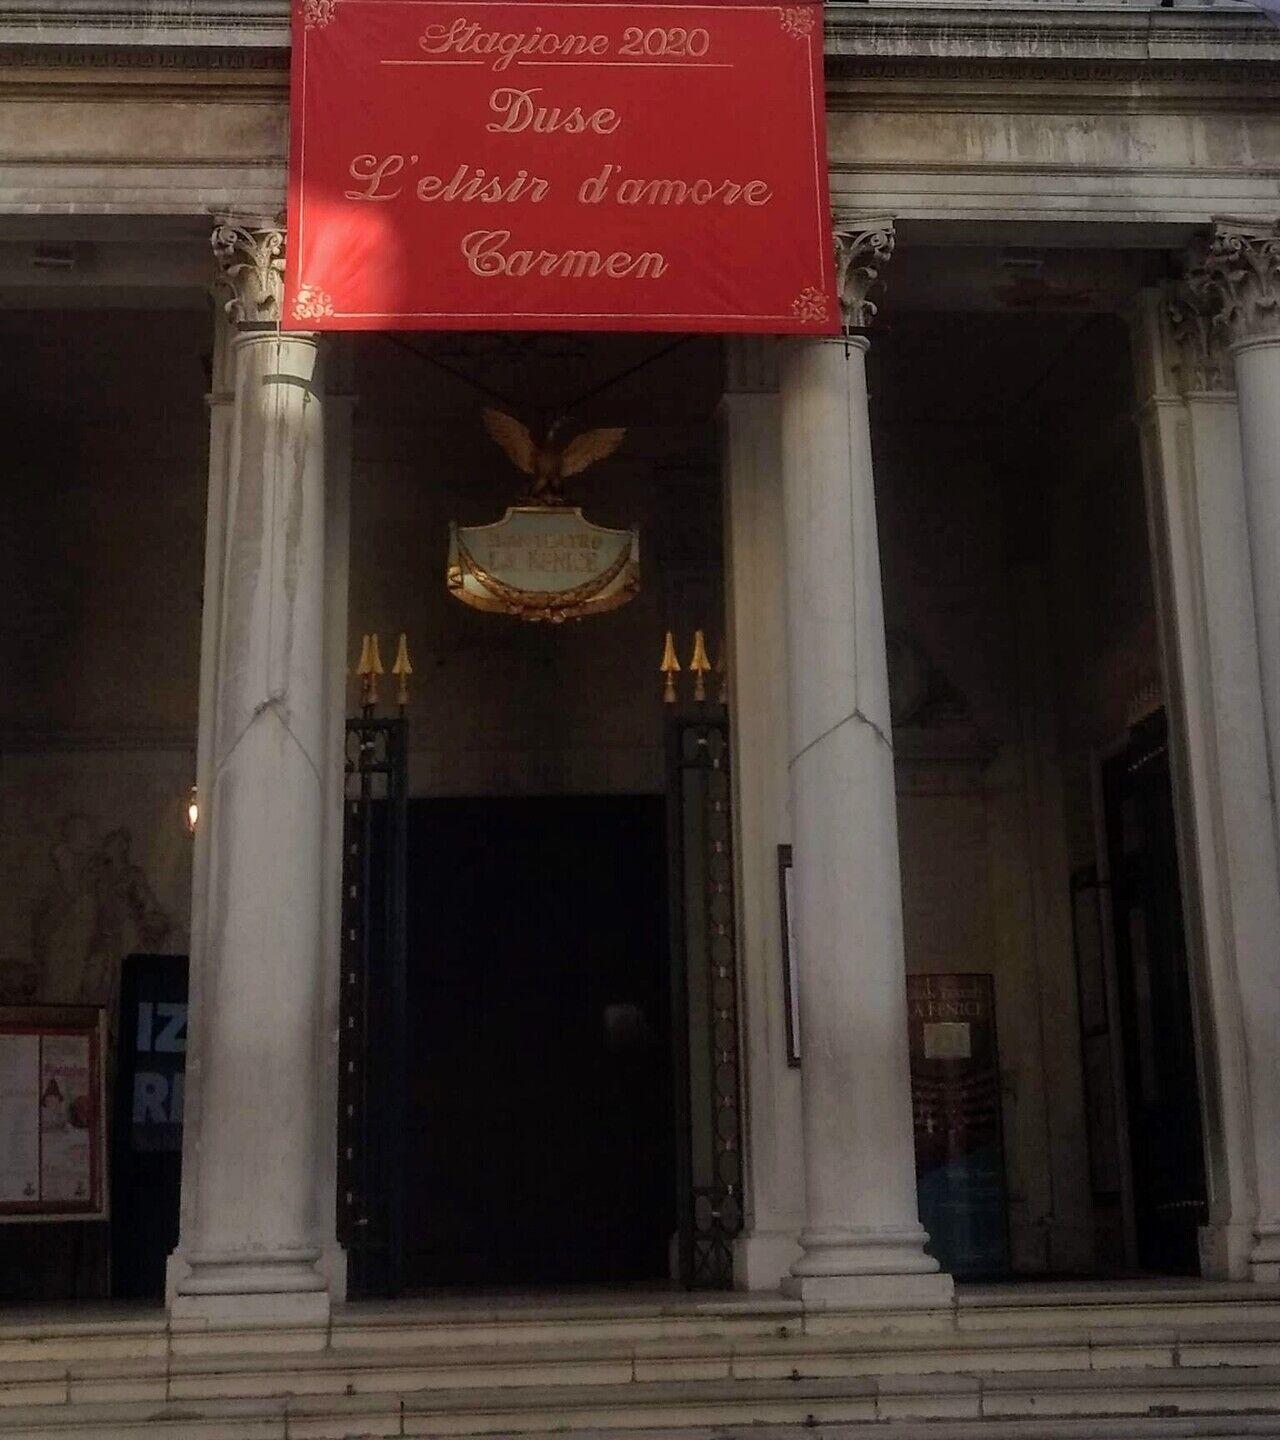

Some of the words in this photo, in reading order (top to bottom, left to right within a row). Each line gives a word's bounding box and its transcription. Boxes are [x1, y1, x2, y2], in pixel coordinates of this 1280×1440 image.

[419, 17, 609, 71] Stagione
[618, 26, 711, 58] 2020
[485, 87, 621, 135] Duse
[343, 153, 550, 205] L'elisir
[577, 164, 773, 208] d'amore
[460, 229, 670, 280] Carmen
